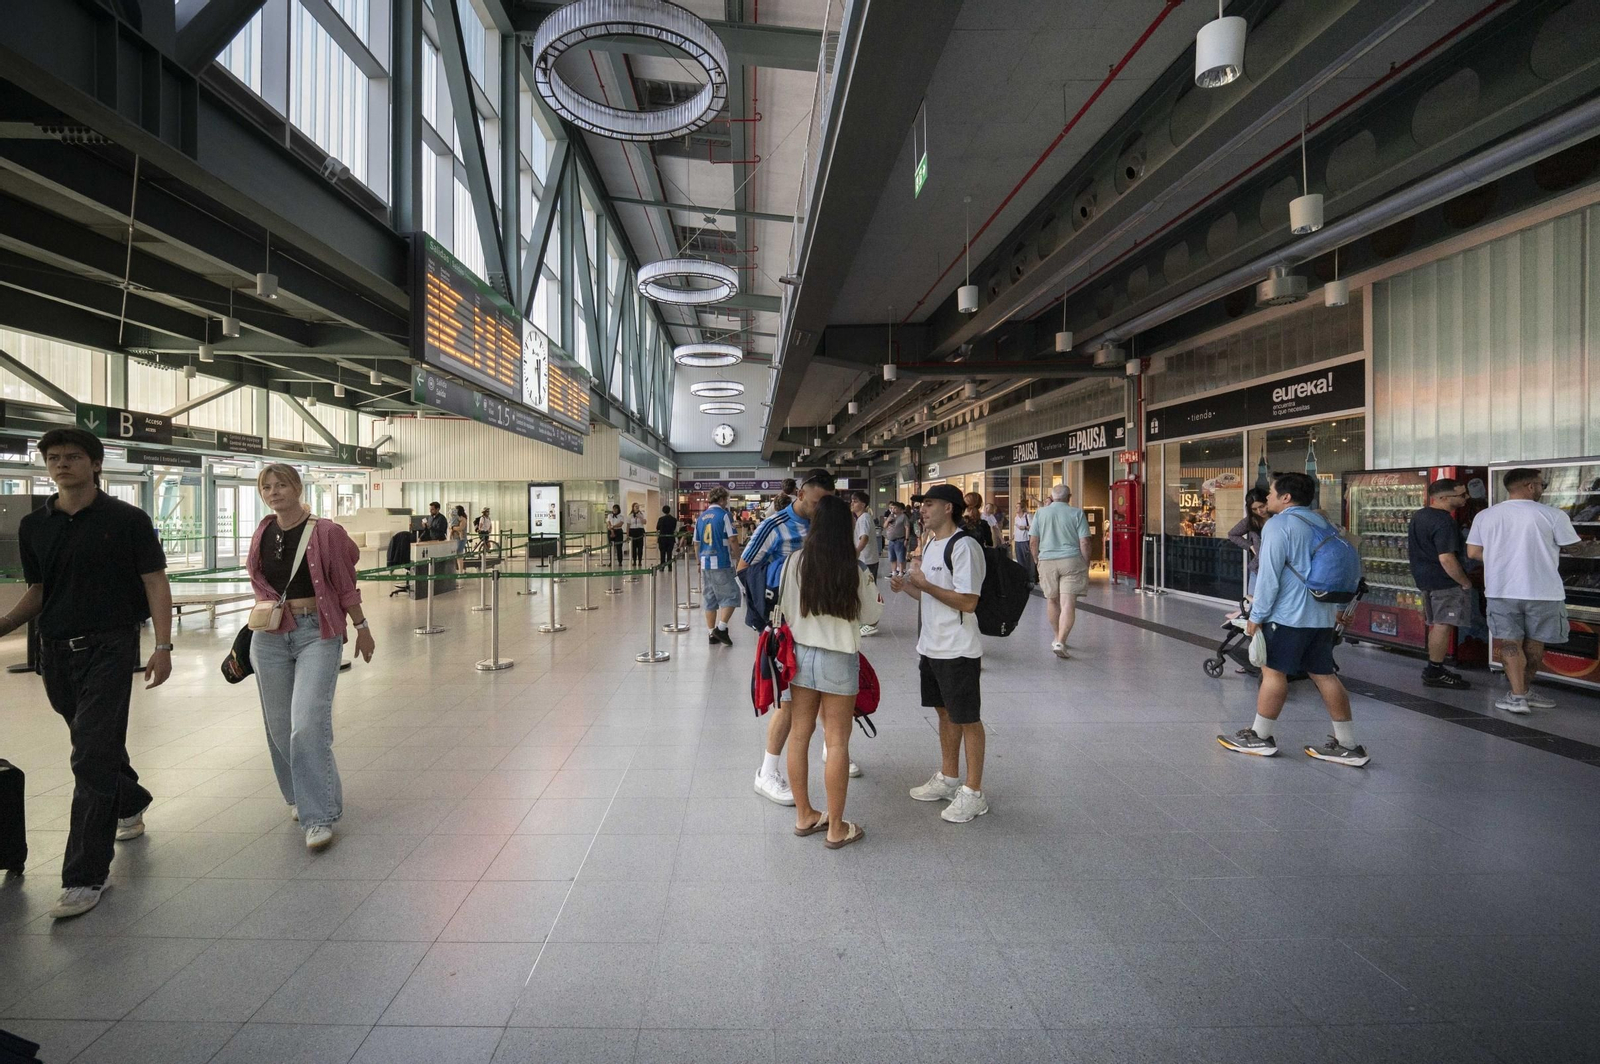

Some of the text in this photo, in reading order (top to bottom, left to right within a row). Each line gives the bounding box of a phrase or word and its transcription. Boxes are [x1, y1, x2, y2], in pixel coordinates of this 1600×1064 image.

[1272, 372, 1333, 402] eureka!
[1191, 409, 1212, 422] tienda
[1273, 401, 1296, 410] encuentra
[1278, 408, 1287, 416] que
[1288, 404, 1310, 413] necesitas
[120, 412, 134, 438] B
[145, 417, 163, 426] Acceso
[1069, 425, 1107, 452] LA PAUSA
[1018, 441, 1039, 462] PAUSA
[703, 523, 713, 546] 4
